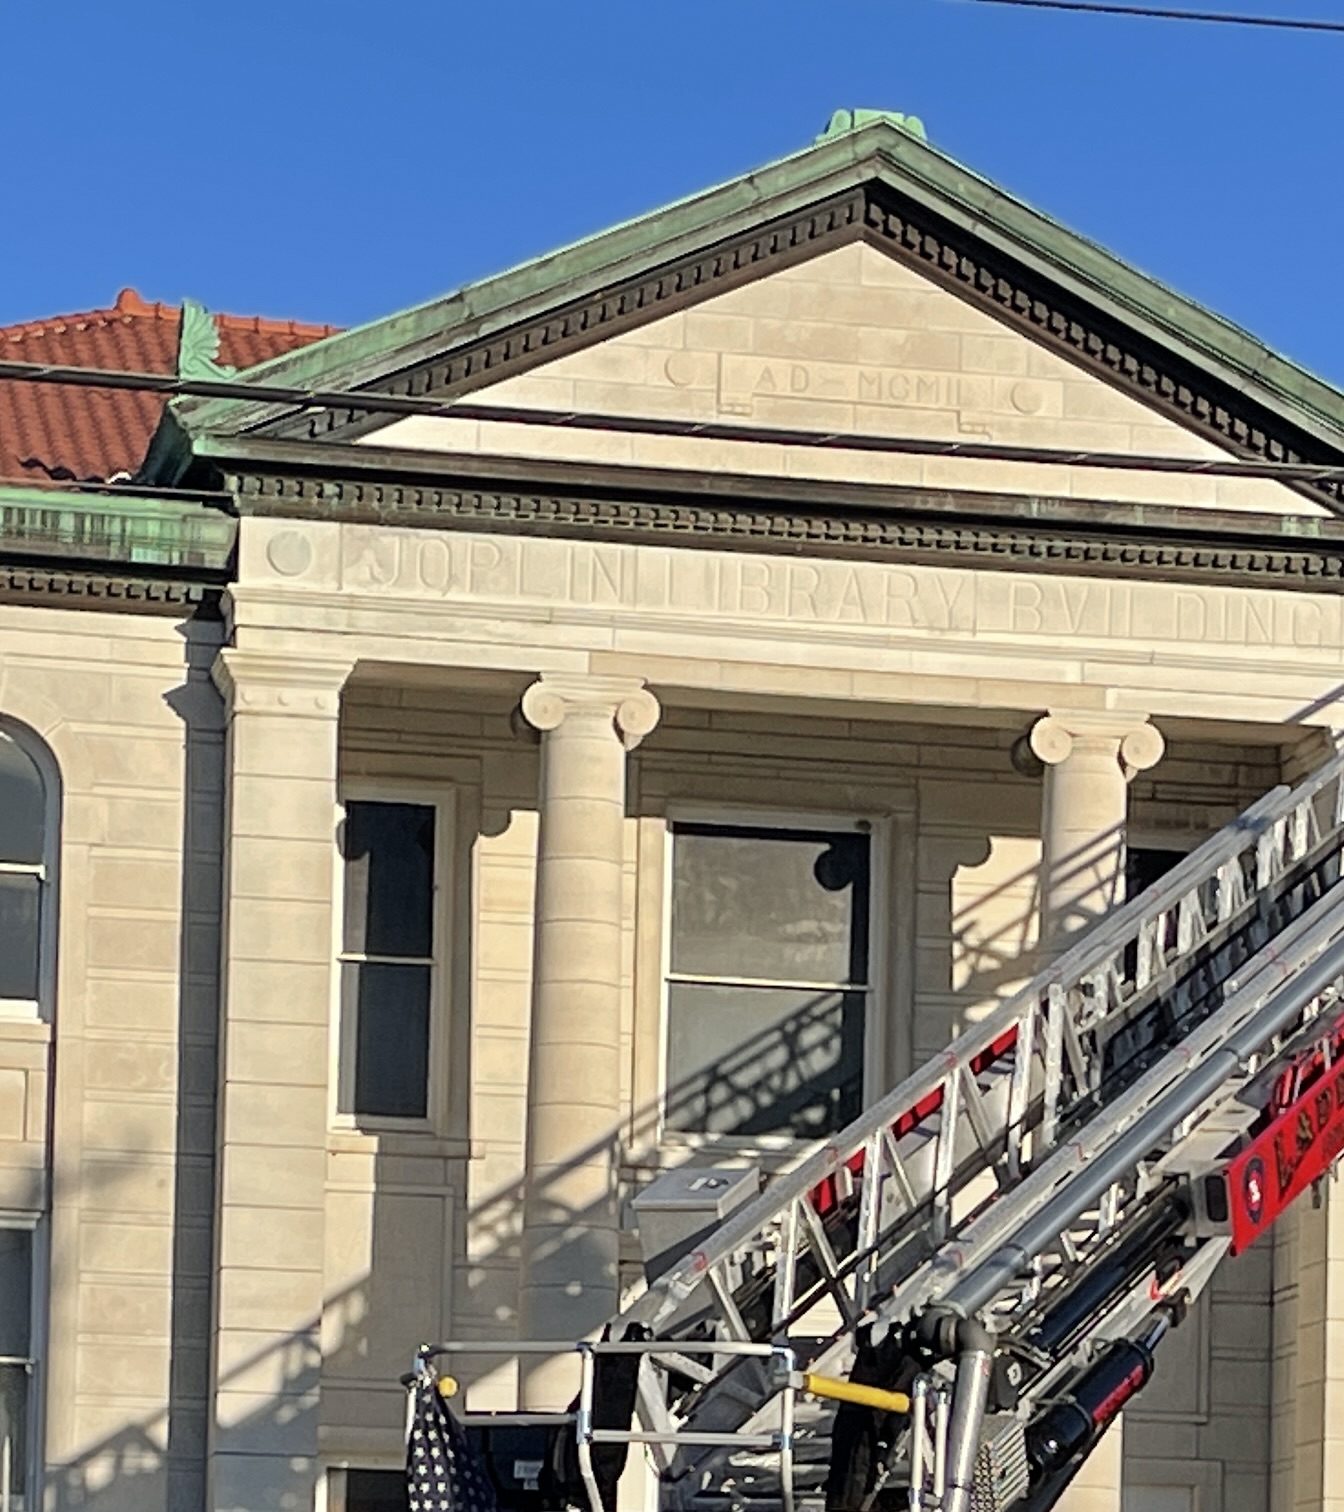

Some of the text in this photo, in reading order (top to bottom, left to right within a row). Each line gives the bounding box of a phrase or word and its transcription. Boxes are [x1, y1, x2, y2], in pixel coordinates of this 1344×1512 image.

[367, 533, 1324, 651] JOPLIN LIBRARY BVILDING
